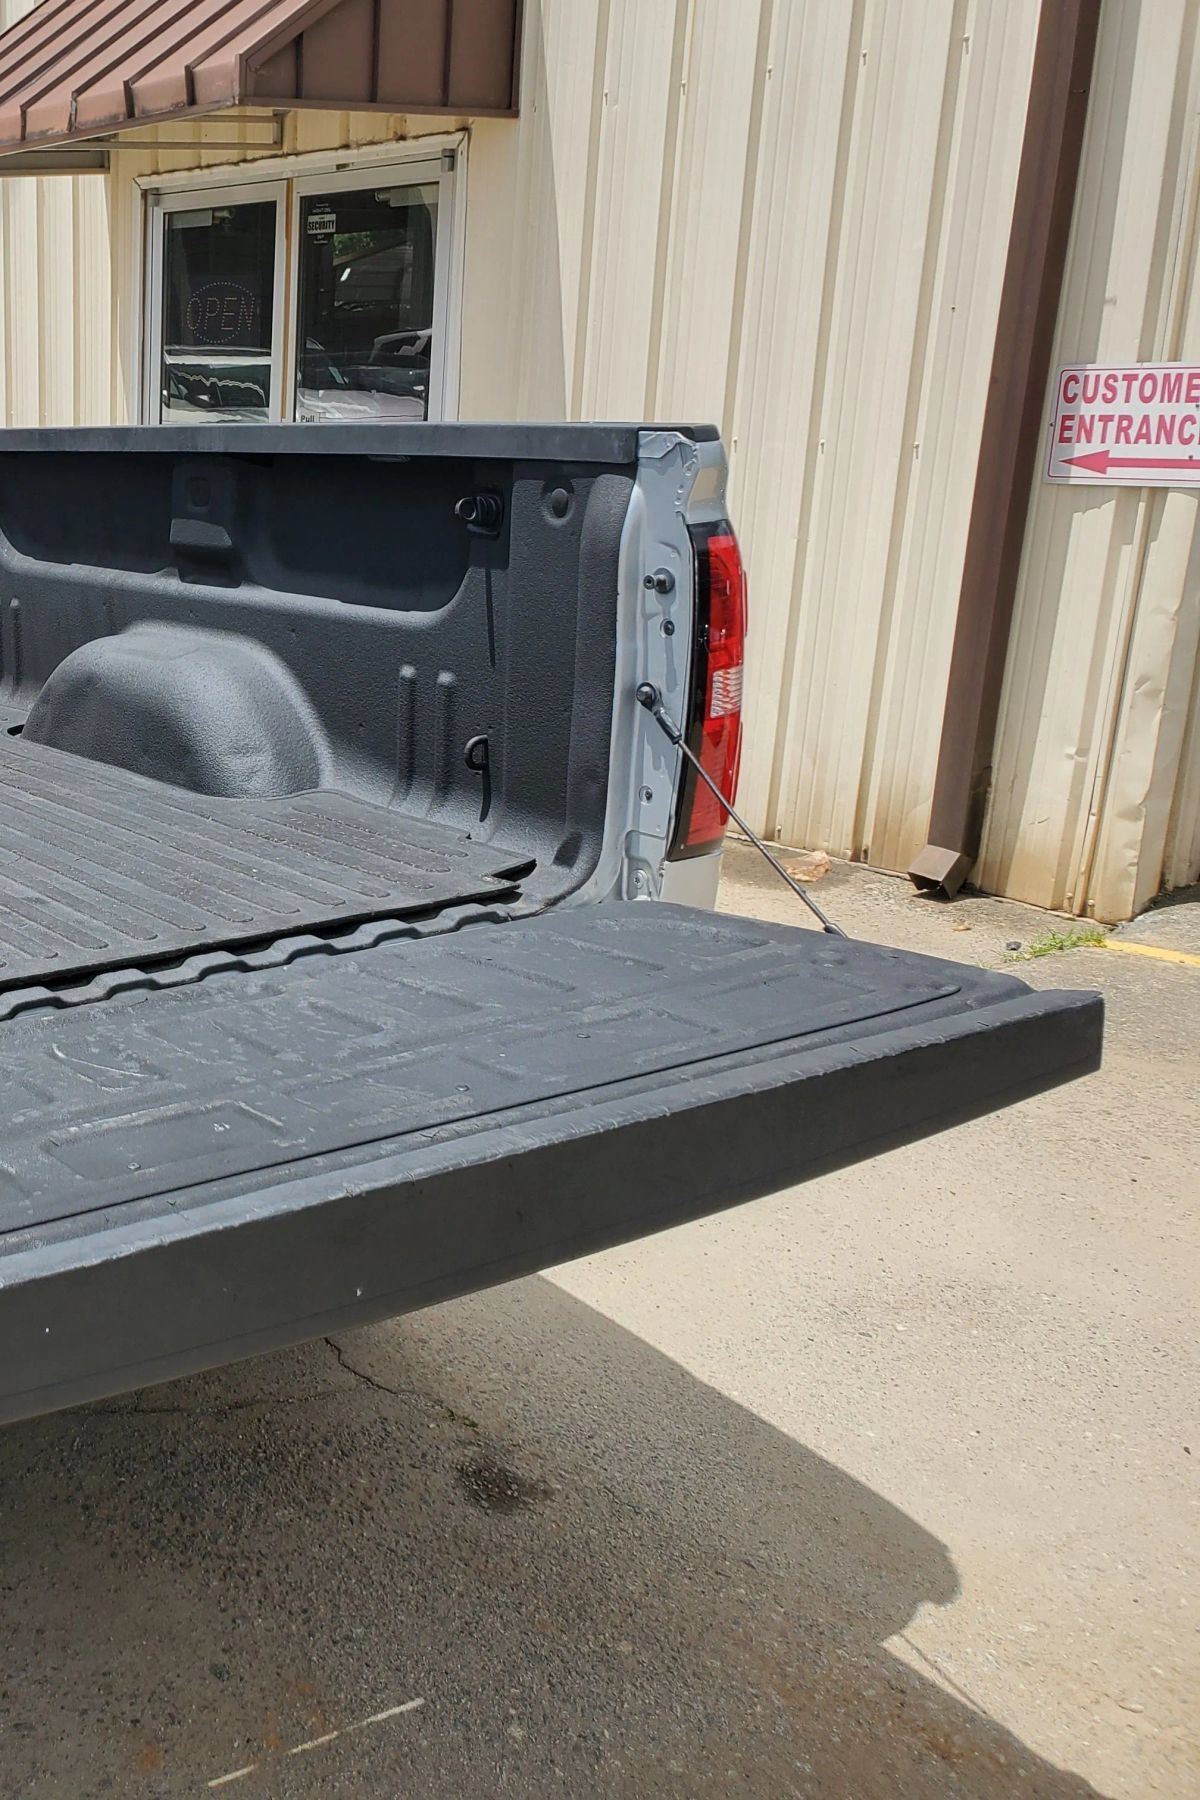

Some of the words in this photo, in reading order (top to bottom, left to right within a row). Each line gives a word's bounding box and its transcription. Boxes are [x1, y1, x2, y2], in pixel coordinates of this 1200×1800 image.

[308, 220, 335, 231] SECURITY
[186, 297, 255, 331] OPEN
[1058, 414, 1200, 446] ENTRANC
